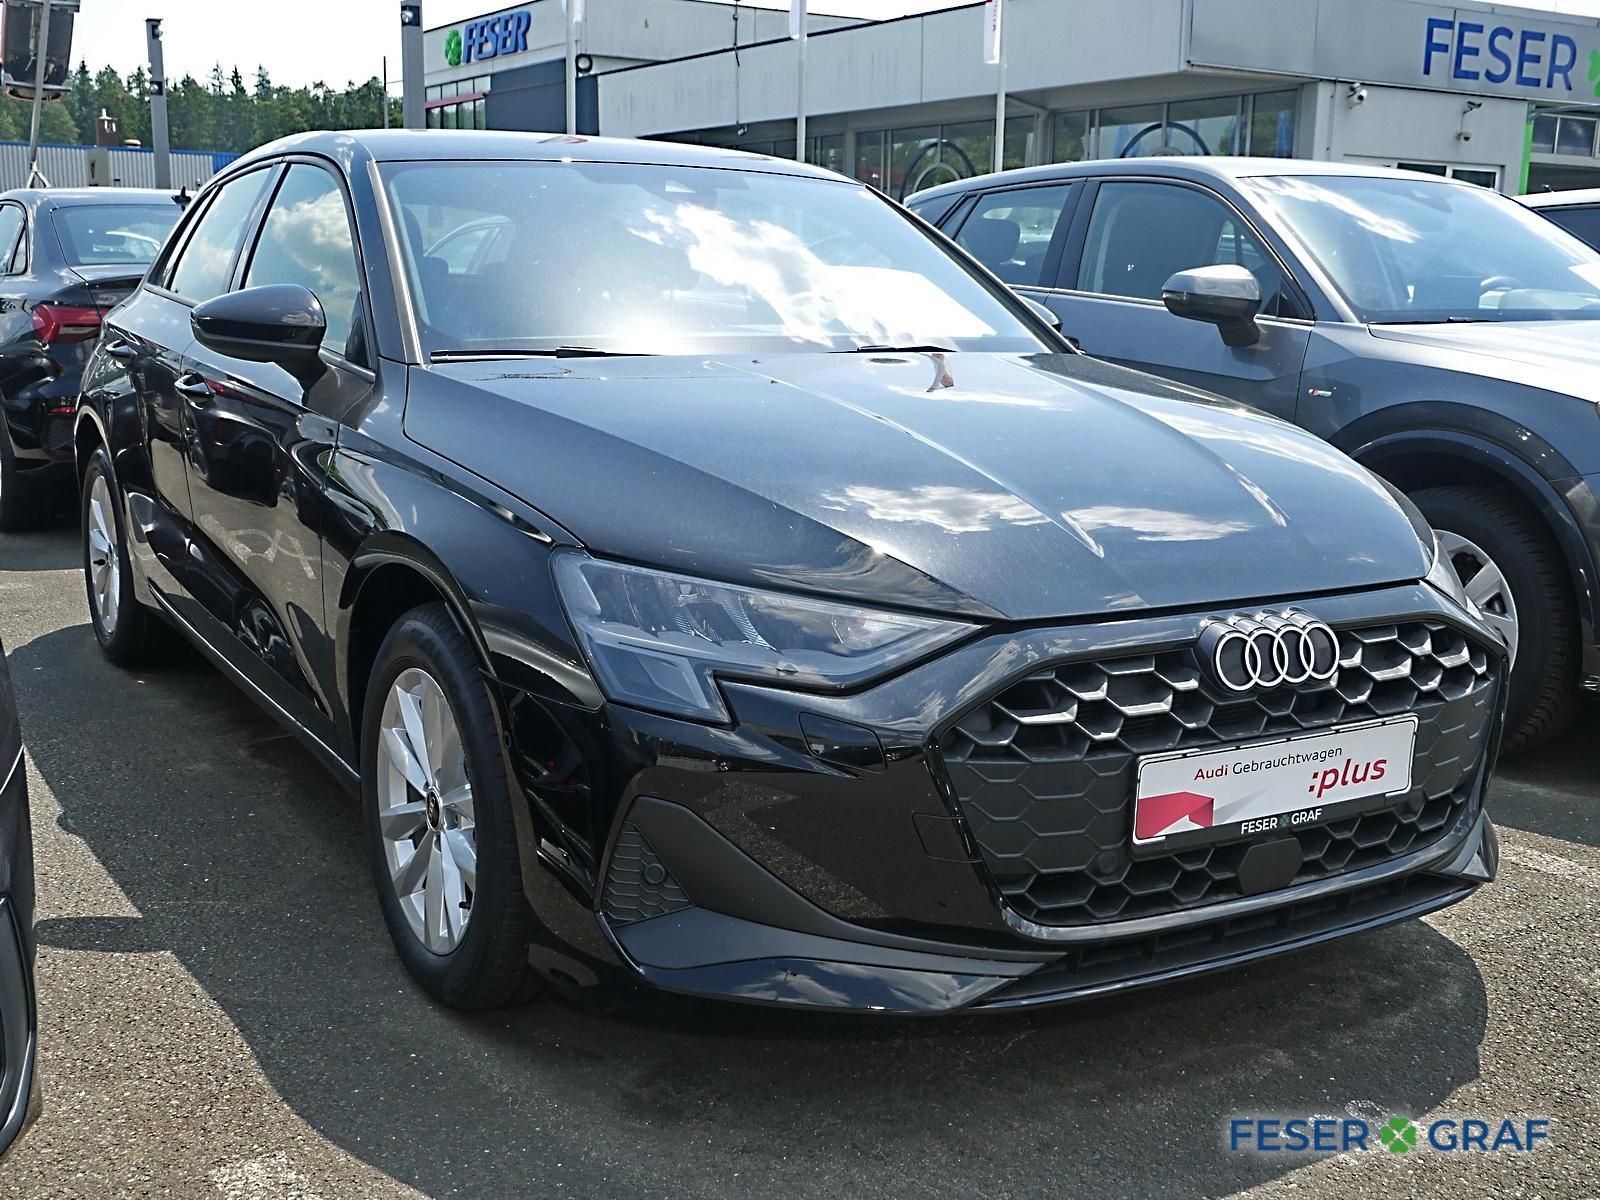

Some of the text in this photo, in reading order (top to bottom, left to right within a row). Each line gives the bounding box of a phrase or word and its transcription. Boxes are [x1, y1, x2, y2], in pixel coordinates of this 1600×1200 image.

[462, 11, 531, 63] FESER
[1423, 18, 1577, 91] FESER
[1194, 747, 1343, 780] Audi Gebrauchtwagen
[1241, 808, 1322, 834] FESER GRAF
